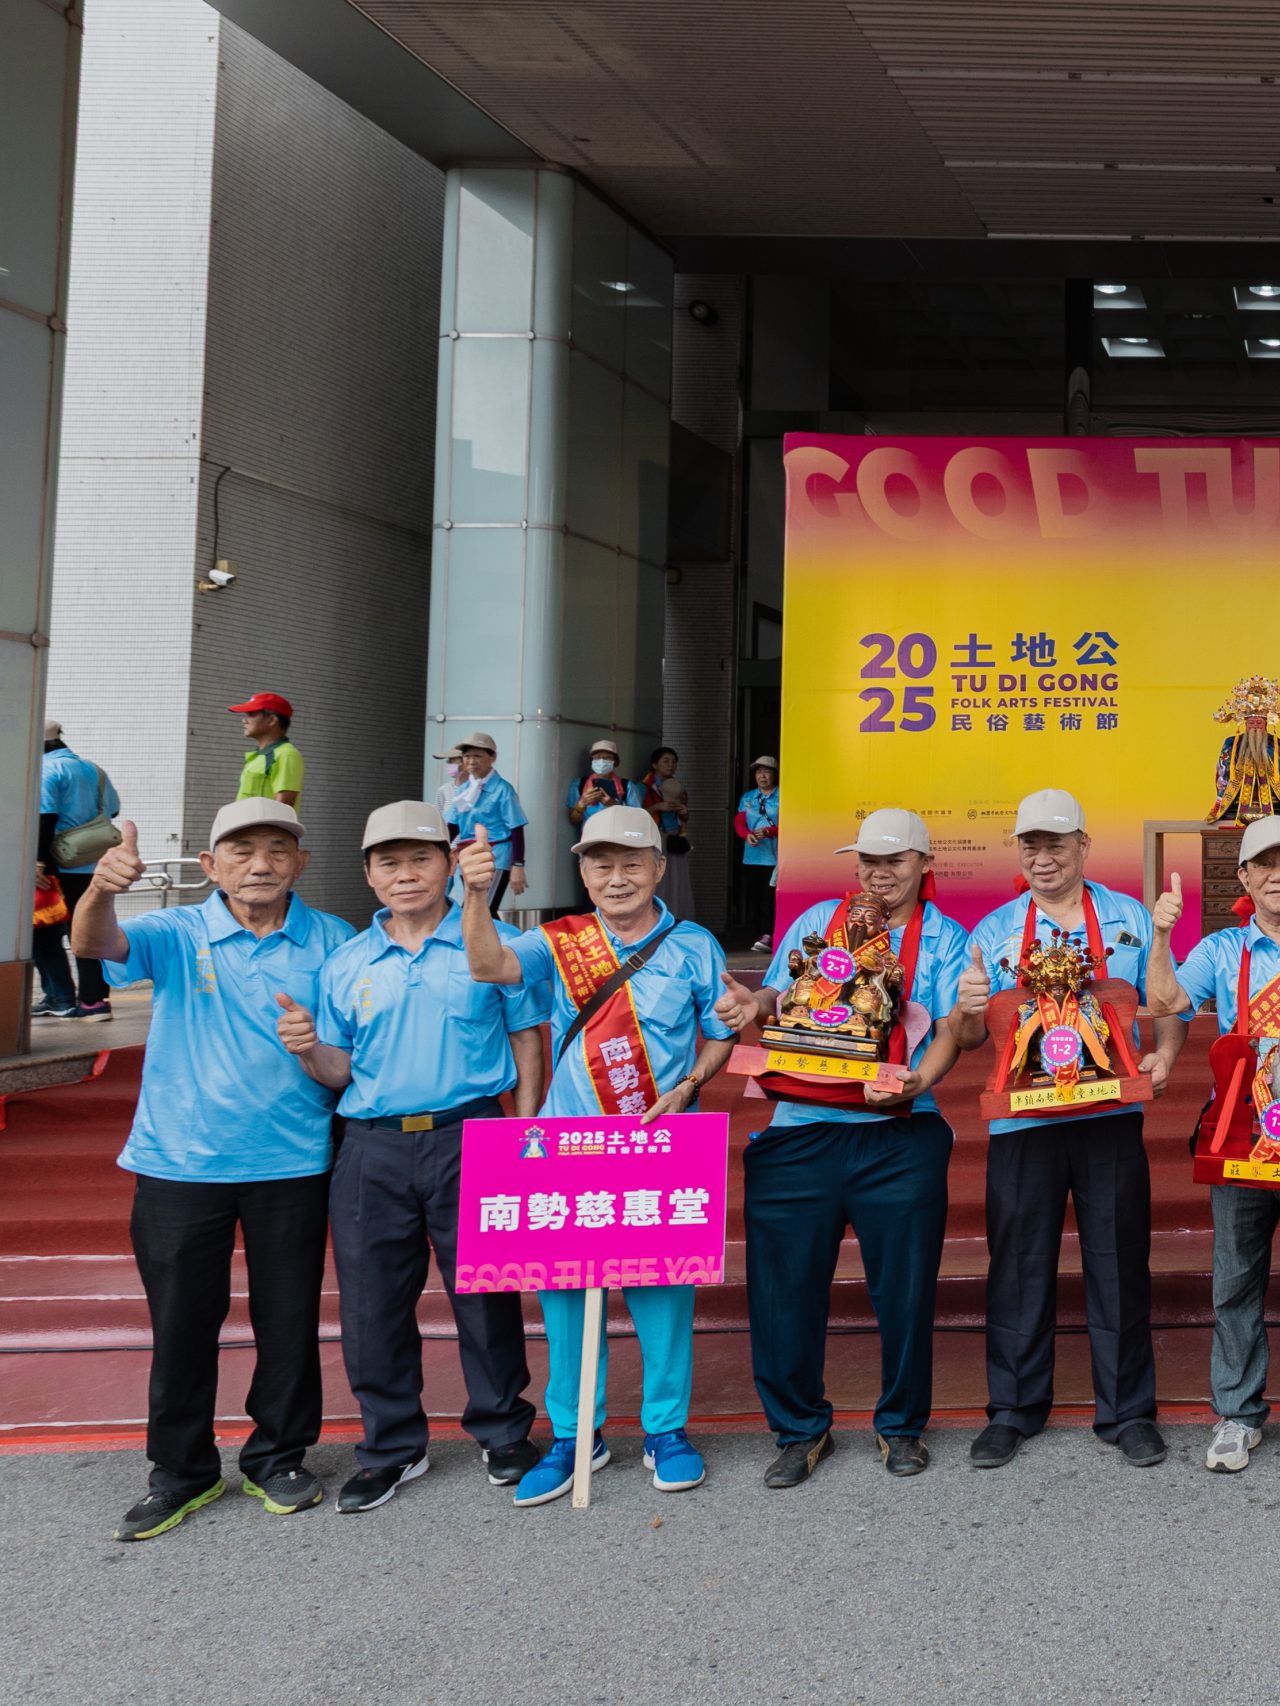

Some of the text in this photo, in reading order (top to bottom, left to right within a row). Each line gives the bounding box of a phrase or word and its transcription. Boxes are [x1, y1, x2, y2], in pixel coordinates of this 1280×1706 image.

[783, 446, 1103, 541] GOOD
[1133, 447, 1280, 539] TU
[858, 632, 937, 679] 20
[950, 632, 1119, 668] 土地公
[952, 673, 1119, 692] TU DI GONG
[858, 686, 937, 733] 25
[951, 697, 1119, 709] FOLK ARTS FESTIVAL
[951, 713, 1119, 732] 民俗藝術節
[826, 961, 846, 975] 2-1
[1051, 1043, 1072, 1055] 1-2
[559, 1129, 672, 1145] 2025 土地公
[480, 1187, 710, 1233] 南勢慈惠堂
